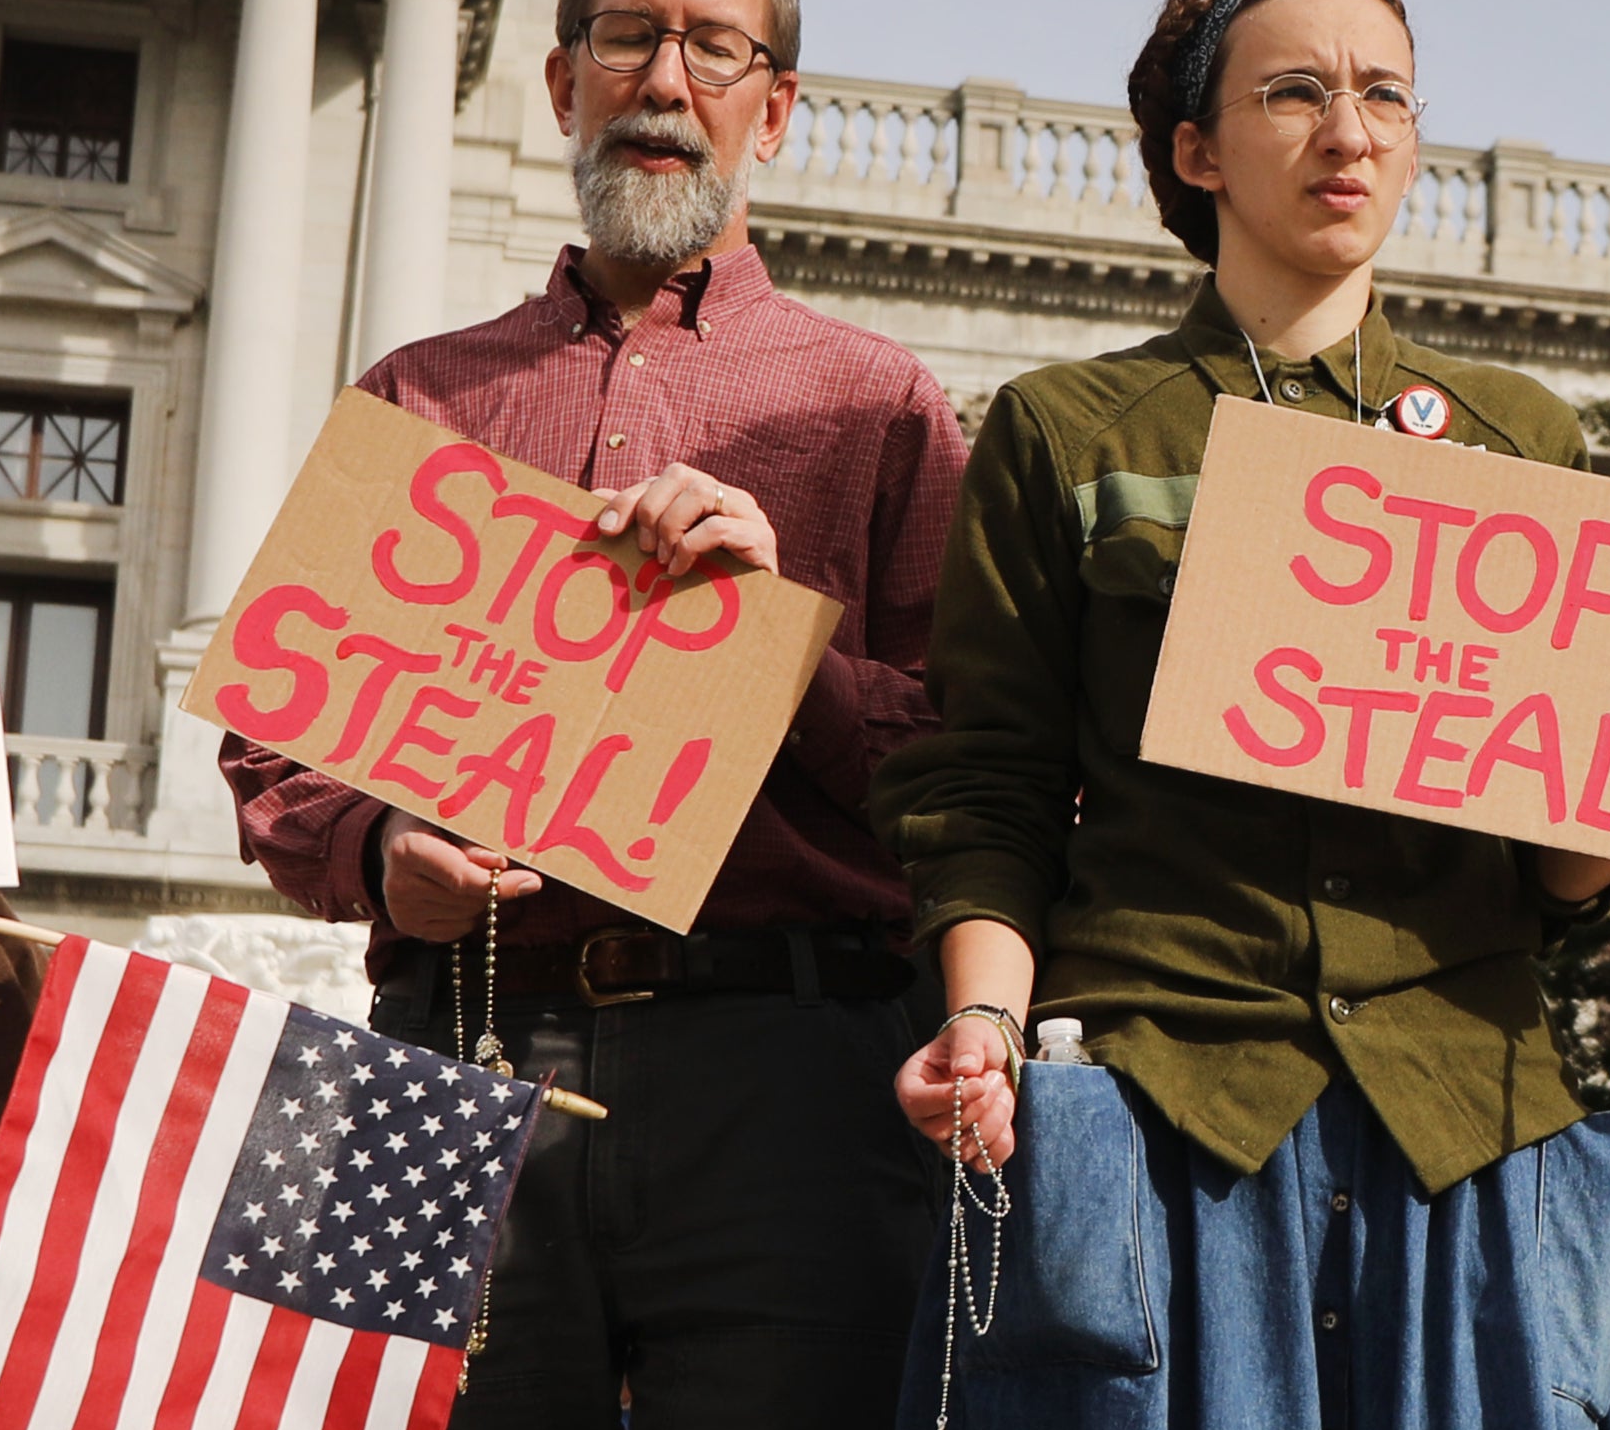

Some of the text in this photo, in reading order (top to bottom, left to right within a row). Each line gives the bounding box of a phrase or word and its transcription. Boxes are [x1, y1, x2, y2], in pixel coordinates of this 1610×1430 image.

[372, 442, 741, 693] STOP
[215, 584, 712, 892] STEAL!
[444, 623, 549, 705] THE
[1376, 628, 1499, 691] THE
